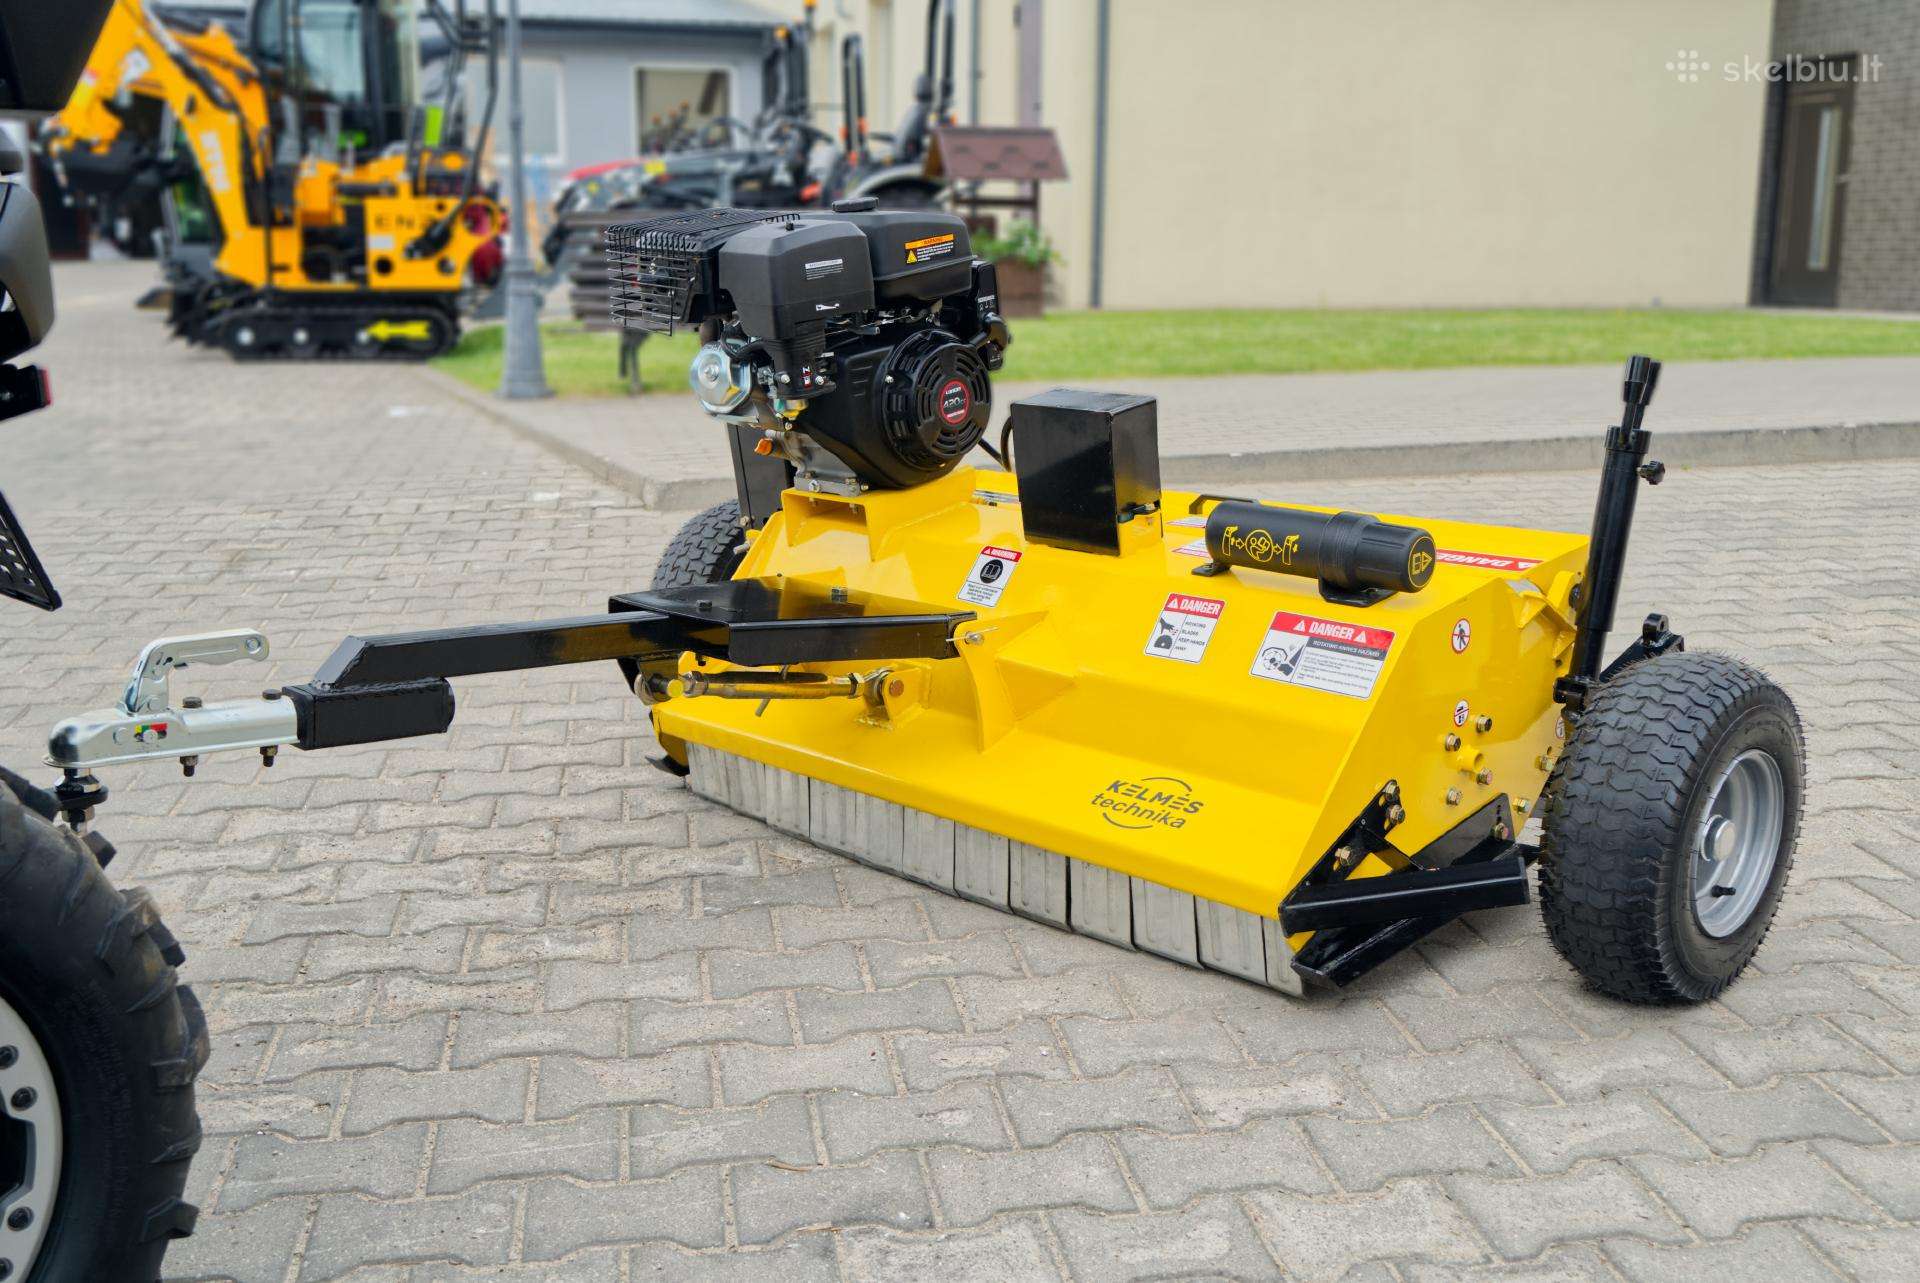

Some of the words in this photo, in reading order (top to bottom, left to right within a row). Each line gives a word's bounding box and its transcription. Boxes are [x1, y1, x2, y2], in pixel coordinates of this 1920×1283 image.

[991, 549, 1017, 560] WARNING
[1436, 552, 1513, 567] DANGE
[1180, 598, 1221, 616] DANGER
[1309, 621, 1355, 641] DANGER
[1313, 640, 1338, 649] ROTATING
[1339, 644, 1357, 653] KNIVES
[1357, 648, 1380, 657] HAZARD
[1091, 792, 1186, 829] technika
